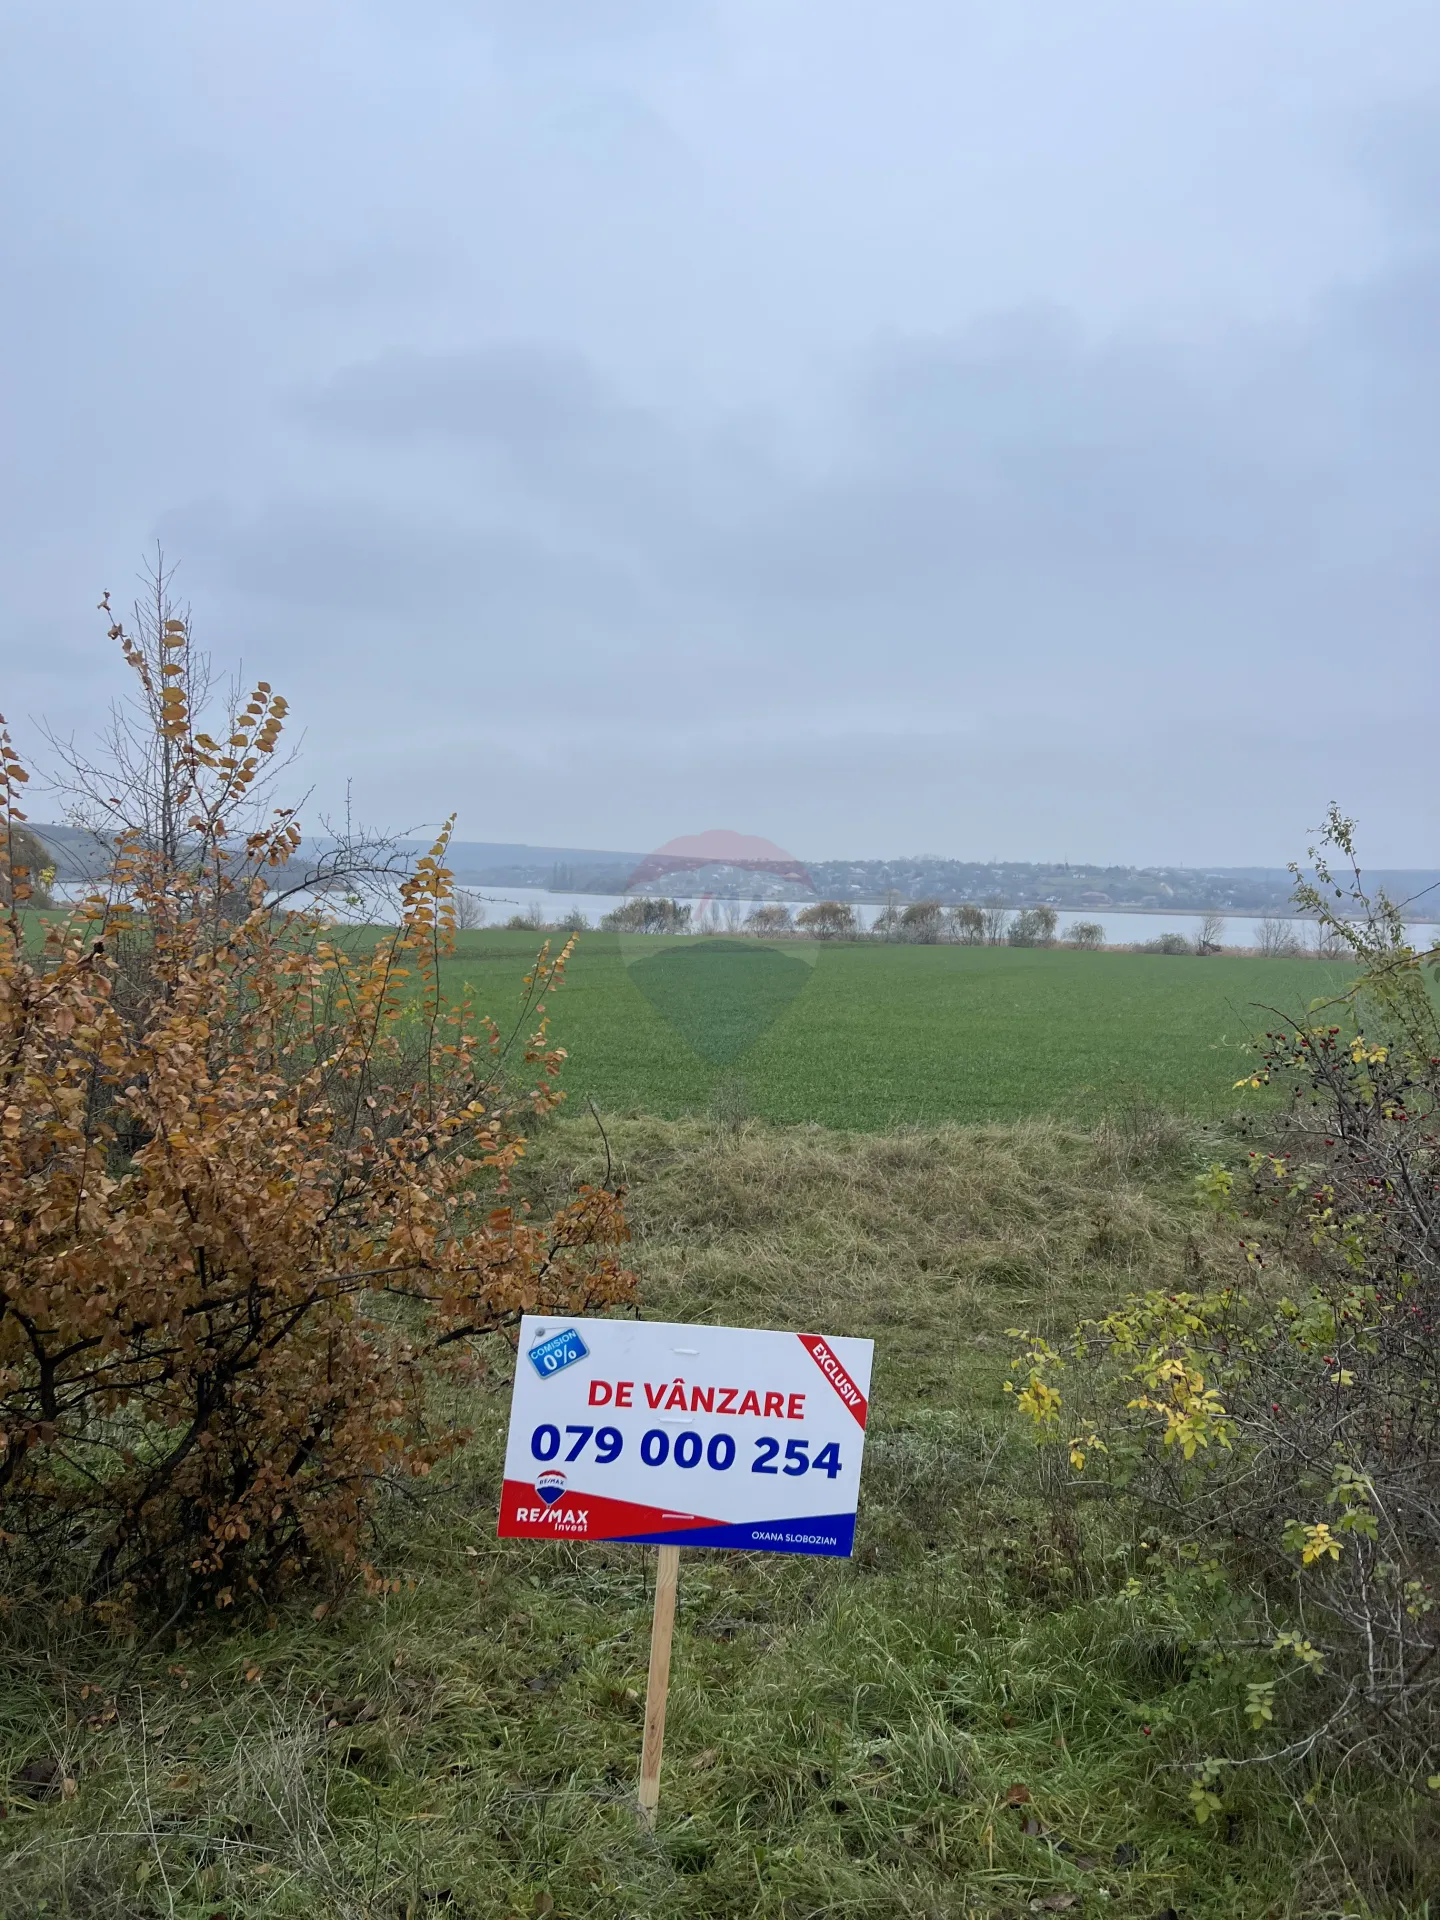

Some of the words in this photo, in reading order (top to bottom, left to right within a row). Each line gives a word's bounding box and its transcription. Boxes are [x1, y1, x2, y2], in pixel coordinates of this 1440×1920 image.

[530, 1330, 577, 1360] COMISION
[543, 1344, 577, 1370] 0%
[812, 1343, 861, 1407] EXCLUSIV
[588, 1379, 633, 1408] DE
[644, 1377, 806, 1420] VÂNZARE
[531, 1424, 623, 1464] 079
[640, 1429, 736, 1471] 000
[751, 1437, 842, 1479] 254
[540, 1478, 565, 1486] RE/MAX
[516, 1507, 589, 1524] RE/MAX
[554, 1522, 588, 1532] Invest
[751, 1531, 783, 1542] OXANA
[785, 1533, 837, 1546] SLOBOZIAN
